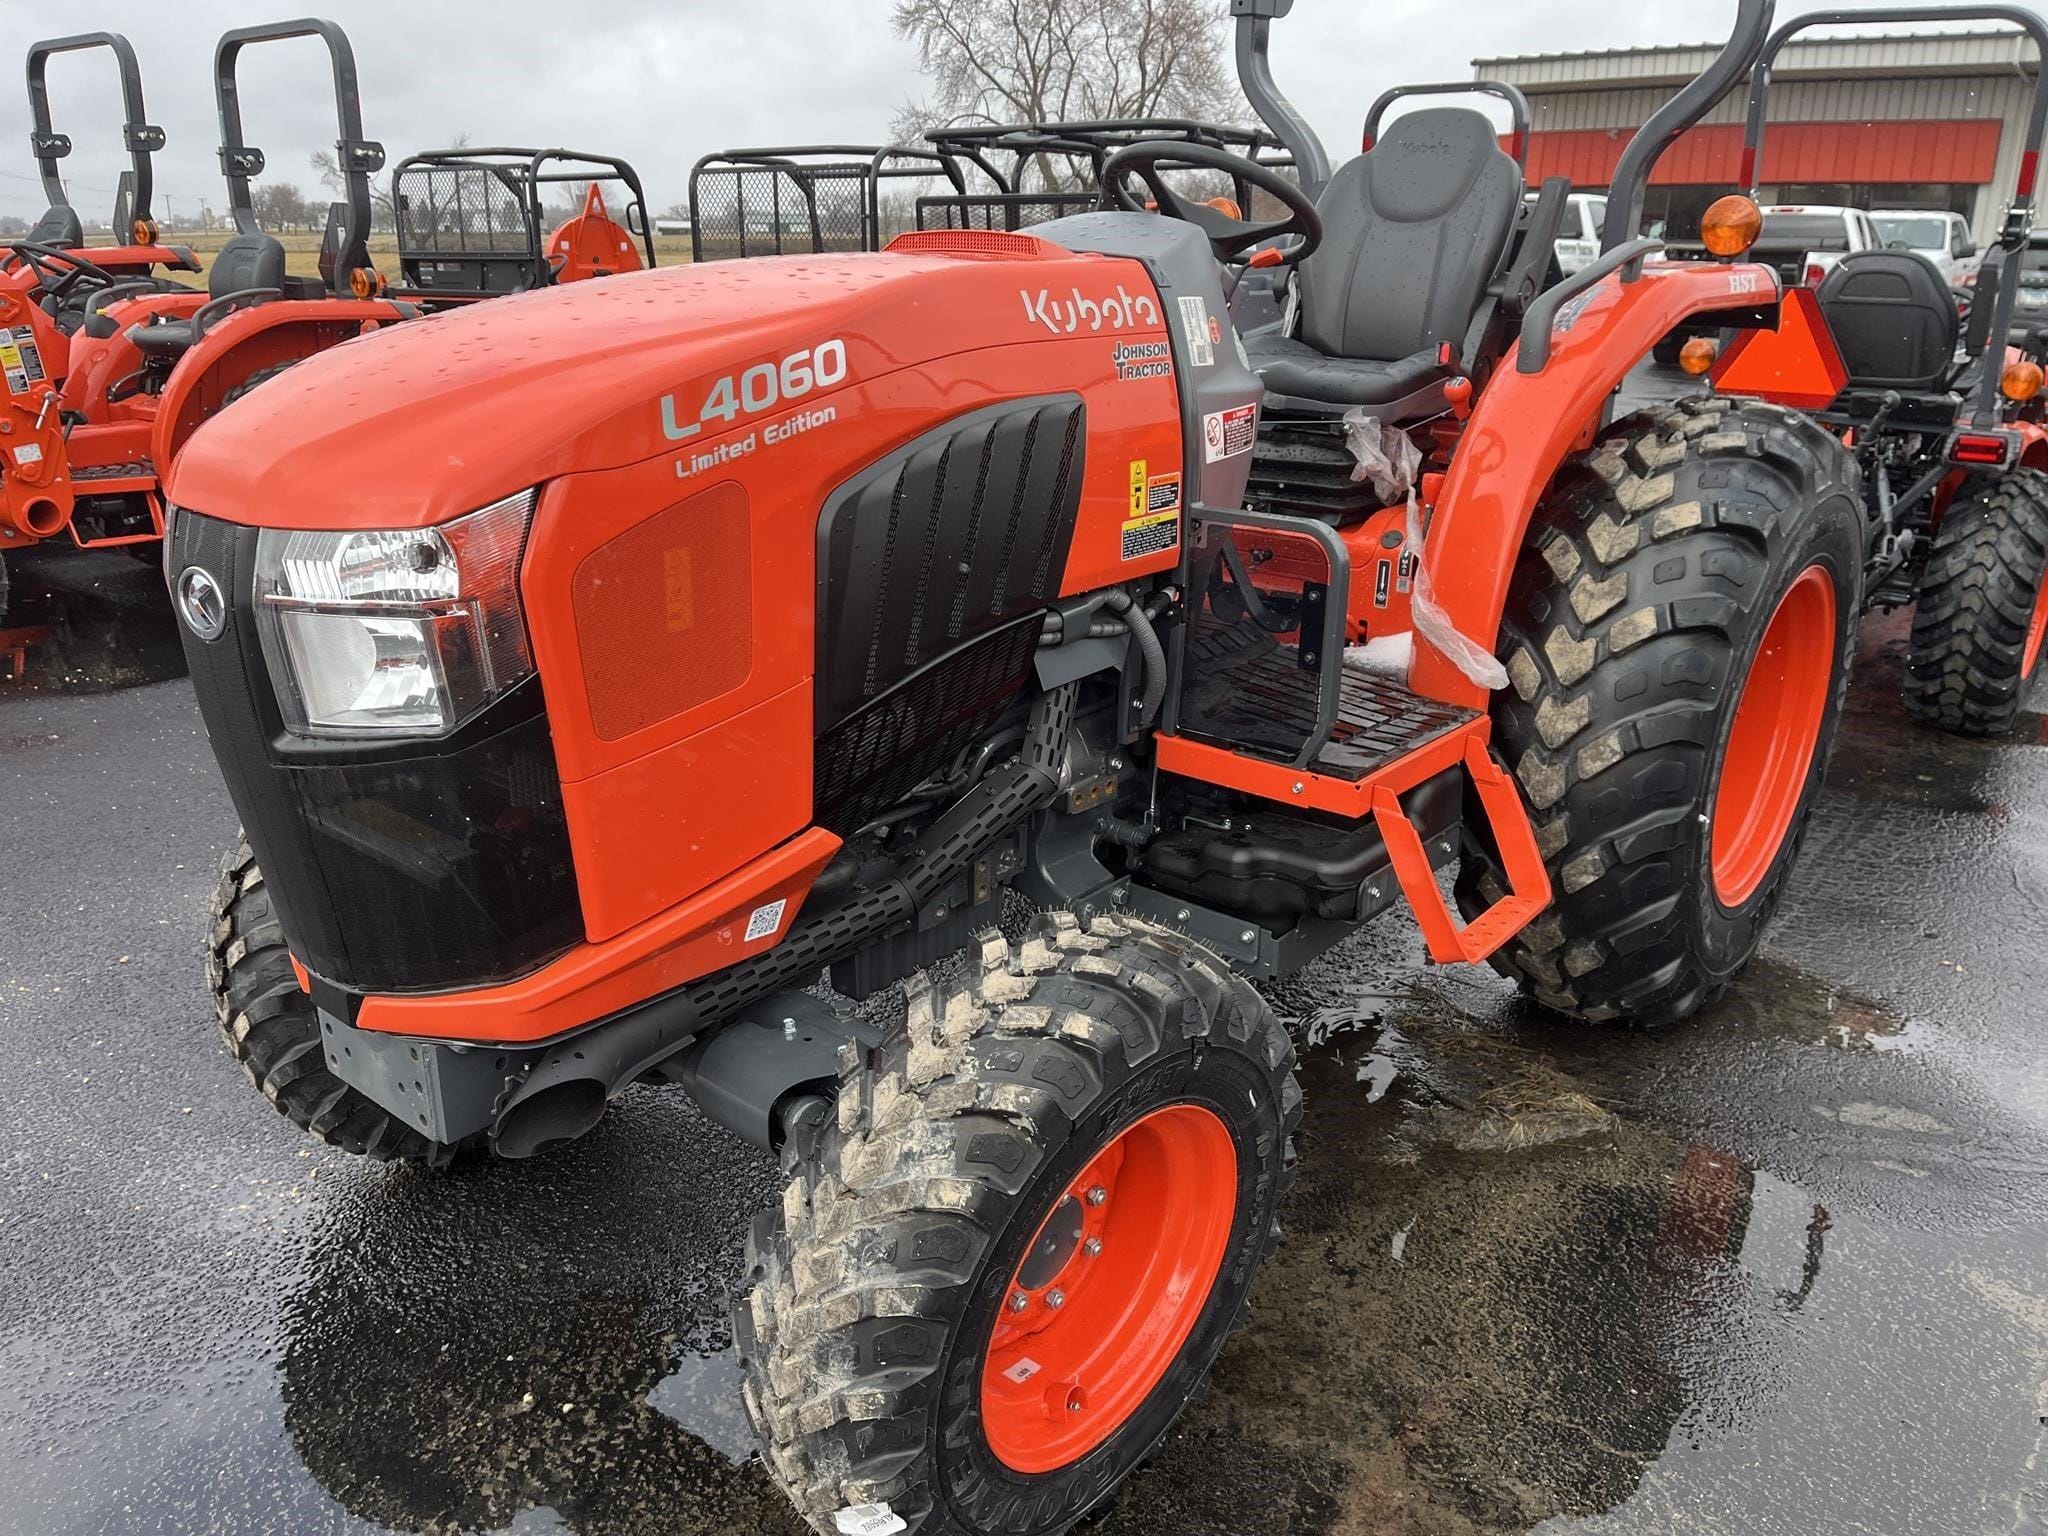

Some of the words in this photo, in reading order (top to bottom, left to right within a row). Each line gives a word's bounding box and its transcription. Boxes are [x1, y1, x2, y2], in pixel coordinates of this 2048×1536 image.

[1728, 273, 1757, 294] HST
[1020, 285, 1158, 334] Kubota
[1112, 341, 1168, 361] JOHNSON
[1116, 361, 1170, 381] TRACTOR
[660, 339, 846, 441] L4060
[675, 433, 756, 478] Limited
[763, 406, 836, 445] Edition
